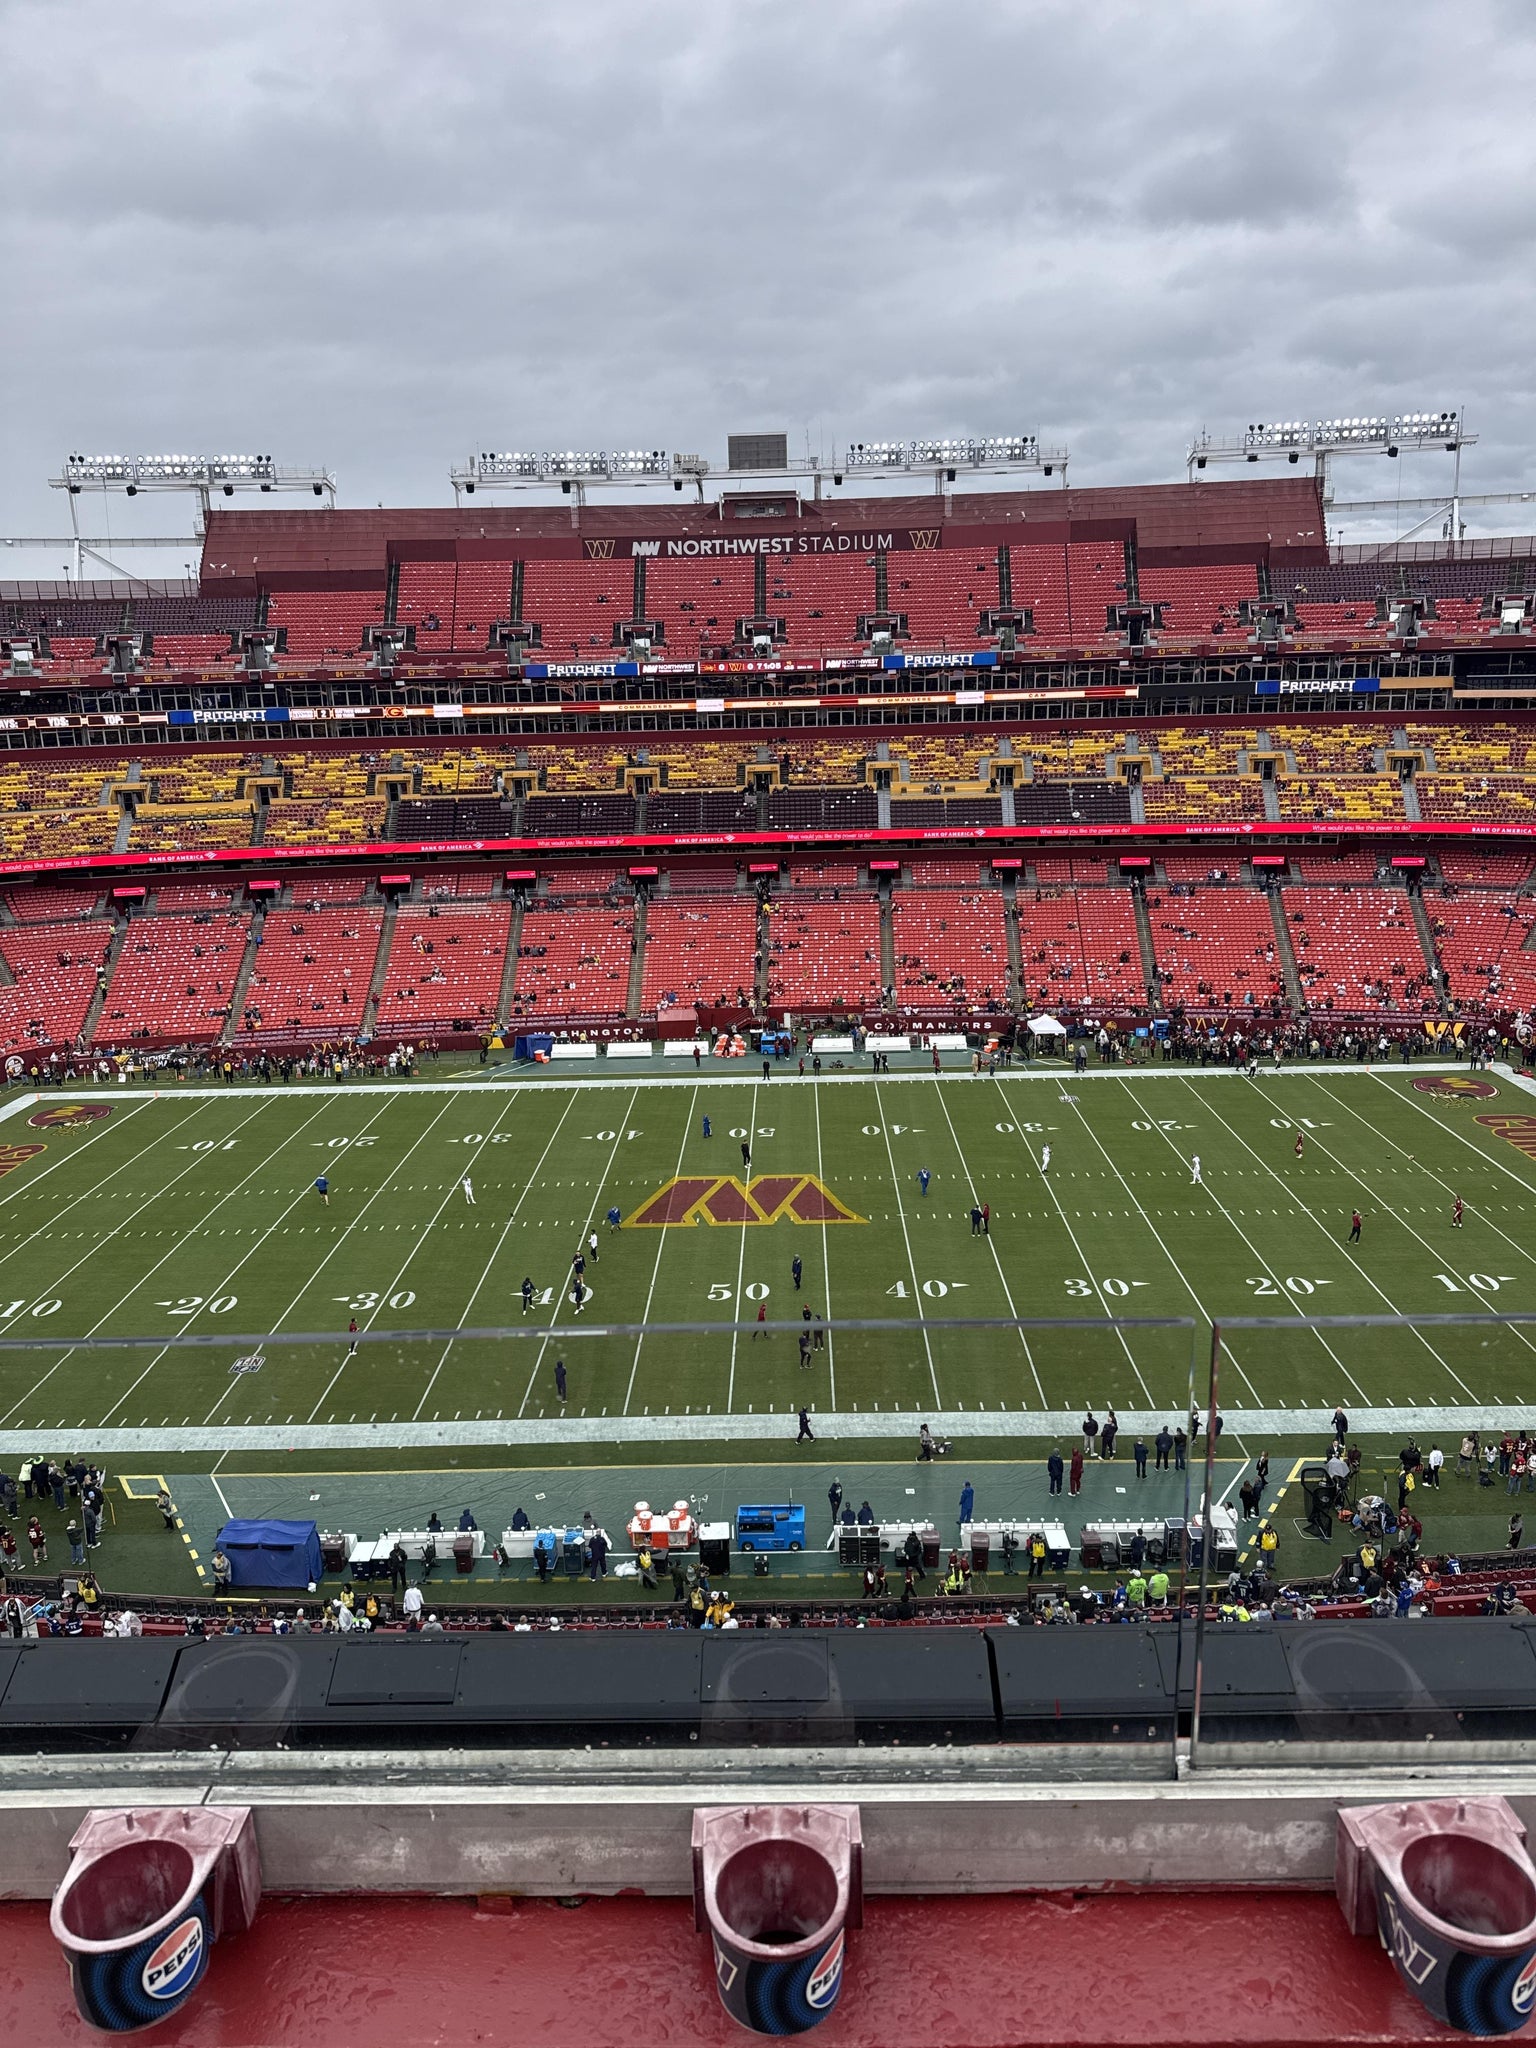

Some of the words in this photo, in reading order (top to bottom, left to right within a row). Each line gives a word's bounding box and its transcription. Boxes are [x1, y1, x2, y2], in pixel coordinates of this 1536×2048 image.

[667, 538, 794, 556] NORTHWEST
[798, 533, 893, 553] STADIUM
[905, 654, 974, 664] PRITCHETT
[547, 664, 616, 674] PRITCHETT
[1280, 680, 1355, 690] PRITCHETT
[193, 710, 267, 720] PRITCHETT
[995, 1122, 1044, 1133] 30
[1131, 1120, 1183, 1132] 20
[1270, 1118, 1320, 1129] 10
[597, 1130, 644, 1141] 40
[728, 1127, 776, 1139] 50
[861, 1124, 908, 1136] 40
[327, 1136, 380, 1148] 20
[463, 1133, 513, 1144] 30
[192, 1140, 242, 1152] 10
[886, 1279, 948, 1298] 40
[1064, 1278, 1130, 1297] 30
[1246, 1276, 1315, 1295] 20
[1432, 1273, 1501, 1292] 10
[531, 1286, 594, 1305] 40
[707, 1283, 770, 1301] 50
[166, 1296, 238, 1315] 20
[348, 1290, 416, 1310] 30
[0, 1299, 63, 1318] 10
[148, 1927, 202, 1987] PEPSI
